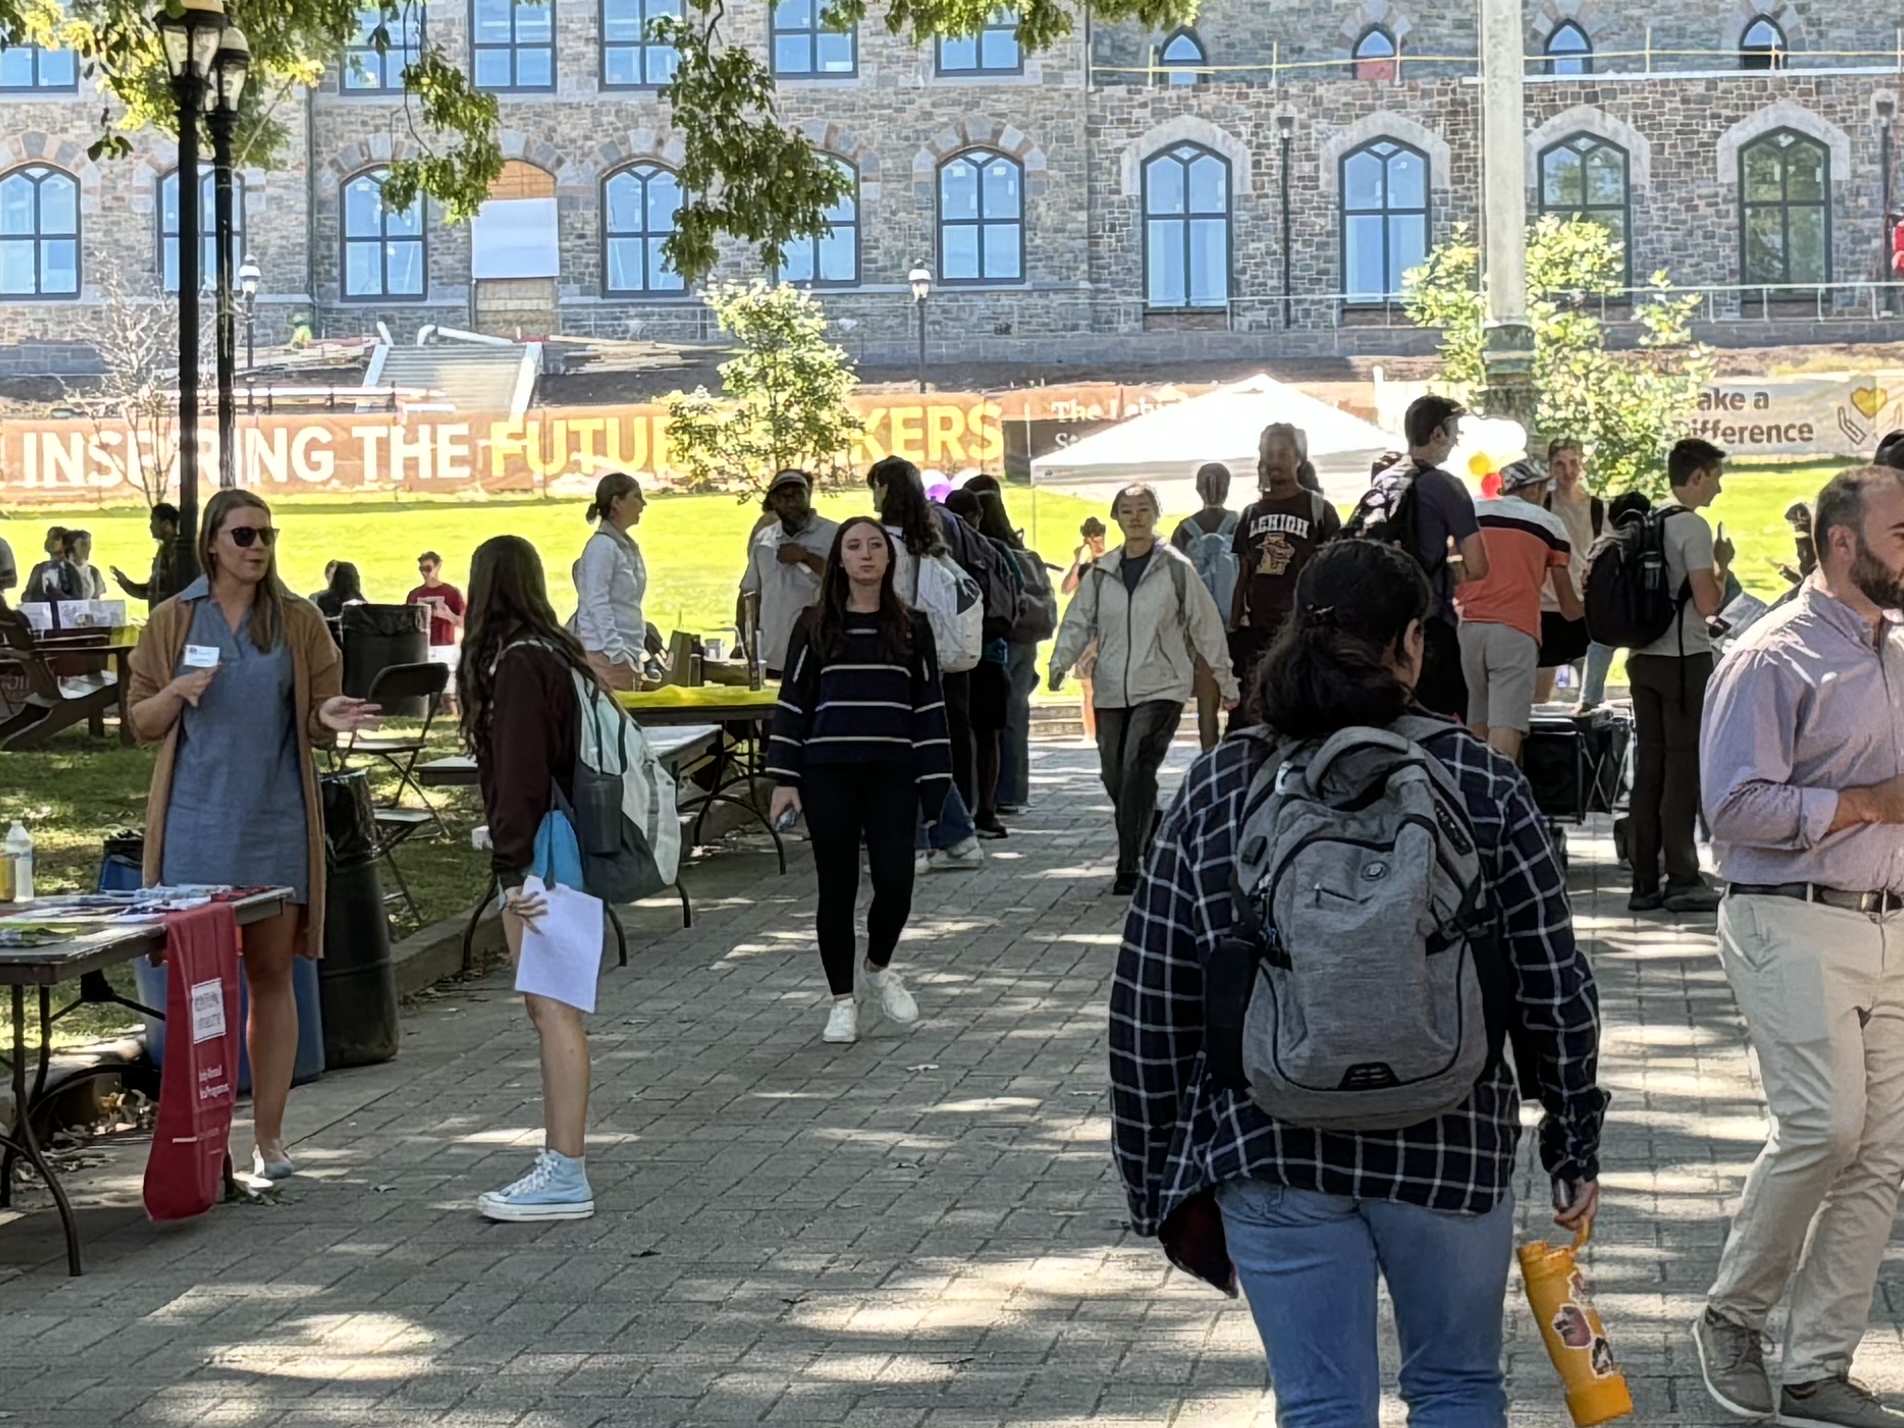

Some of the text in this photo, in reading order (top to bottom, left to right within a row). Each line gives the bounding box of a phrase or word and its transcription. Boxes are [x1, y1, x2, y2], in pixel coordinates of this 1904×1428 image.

[1696, 387, 1769, 411] ake a
[351, 422, 471, 481] THE
[490, 407, 688, 476] FUTU
[1248, 513, 1309, 540] LEHIGH
